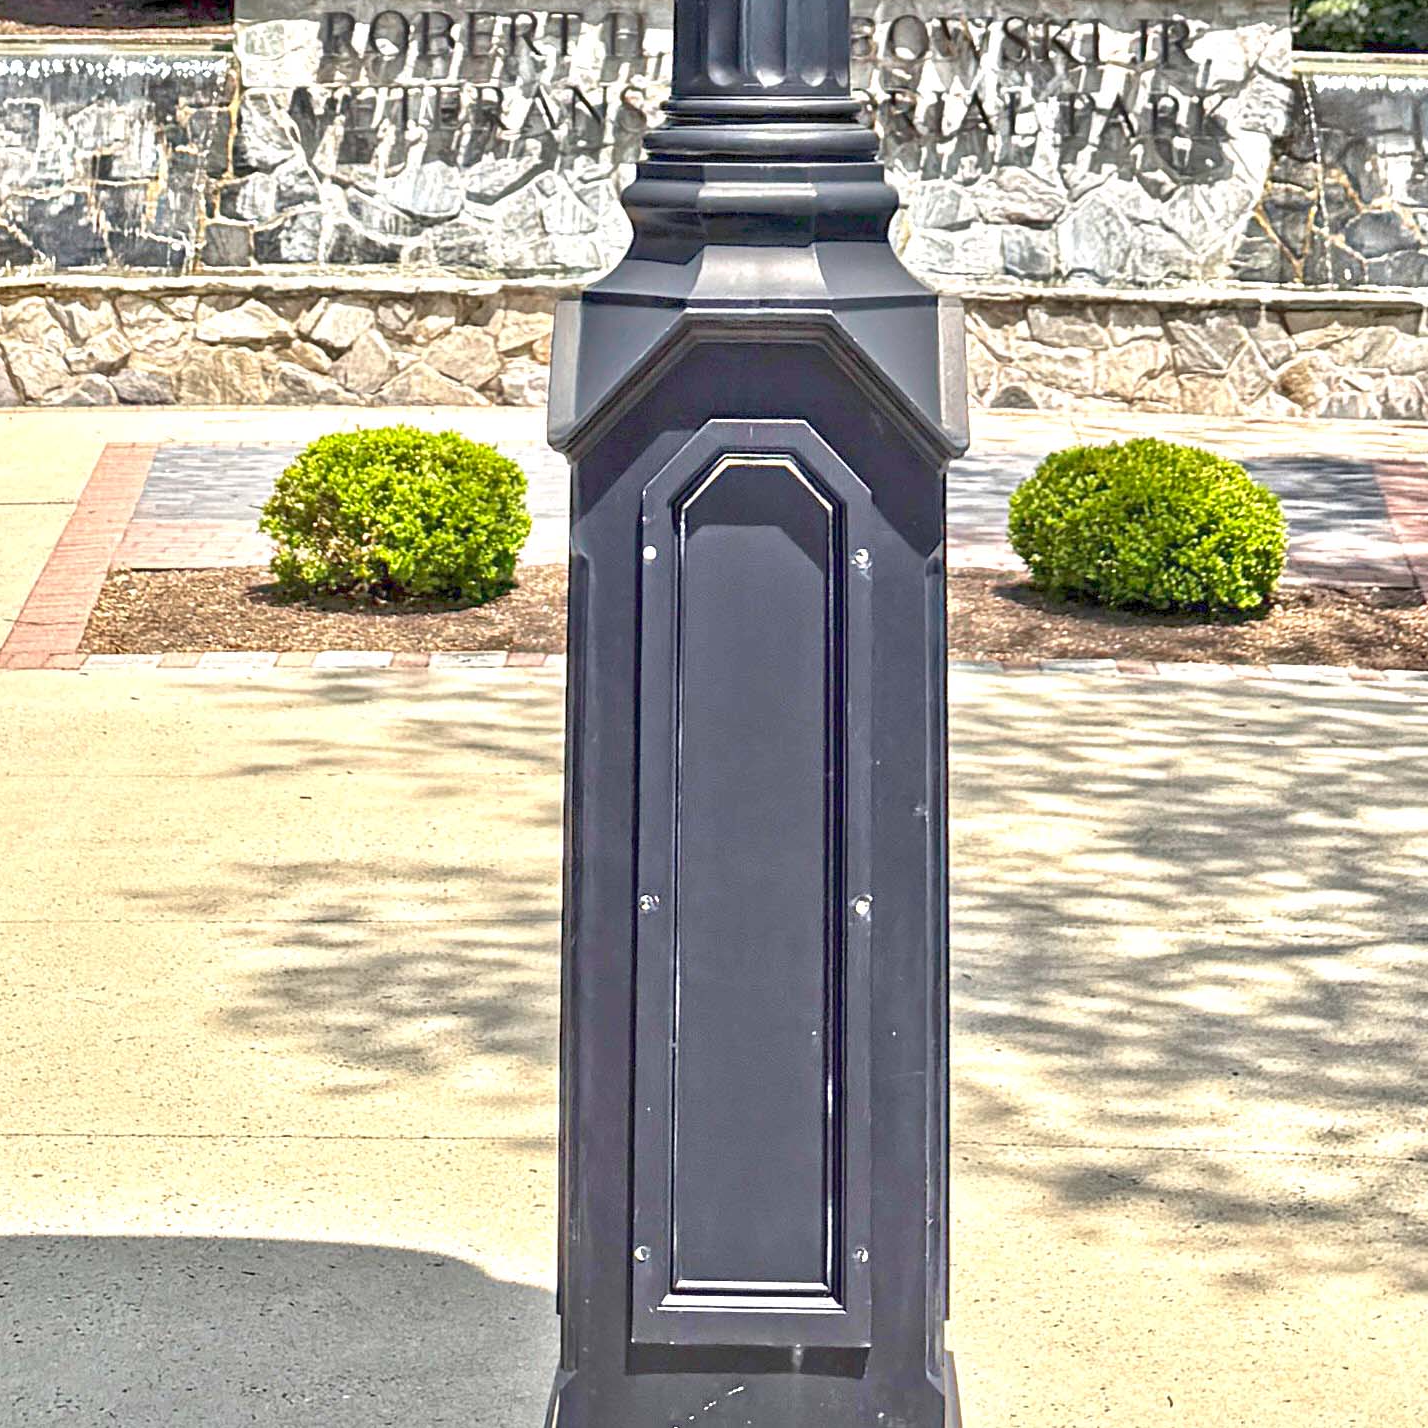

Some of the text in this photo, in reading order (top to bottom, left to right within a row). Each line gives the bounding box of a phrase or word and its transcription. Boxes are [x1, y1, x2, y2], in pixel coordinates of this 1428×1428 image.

[323, 10, 582, 58] ROBERT
[850, 14, 1102, 66] BOWSKI
[291, 85, 648, 132] VETERANS
[1065, 92, 1235, 138] PARK
